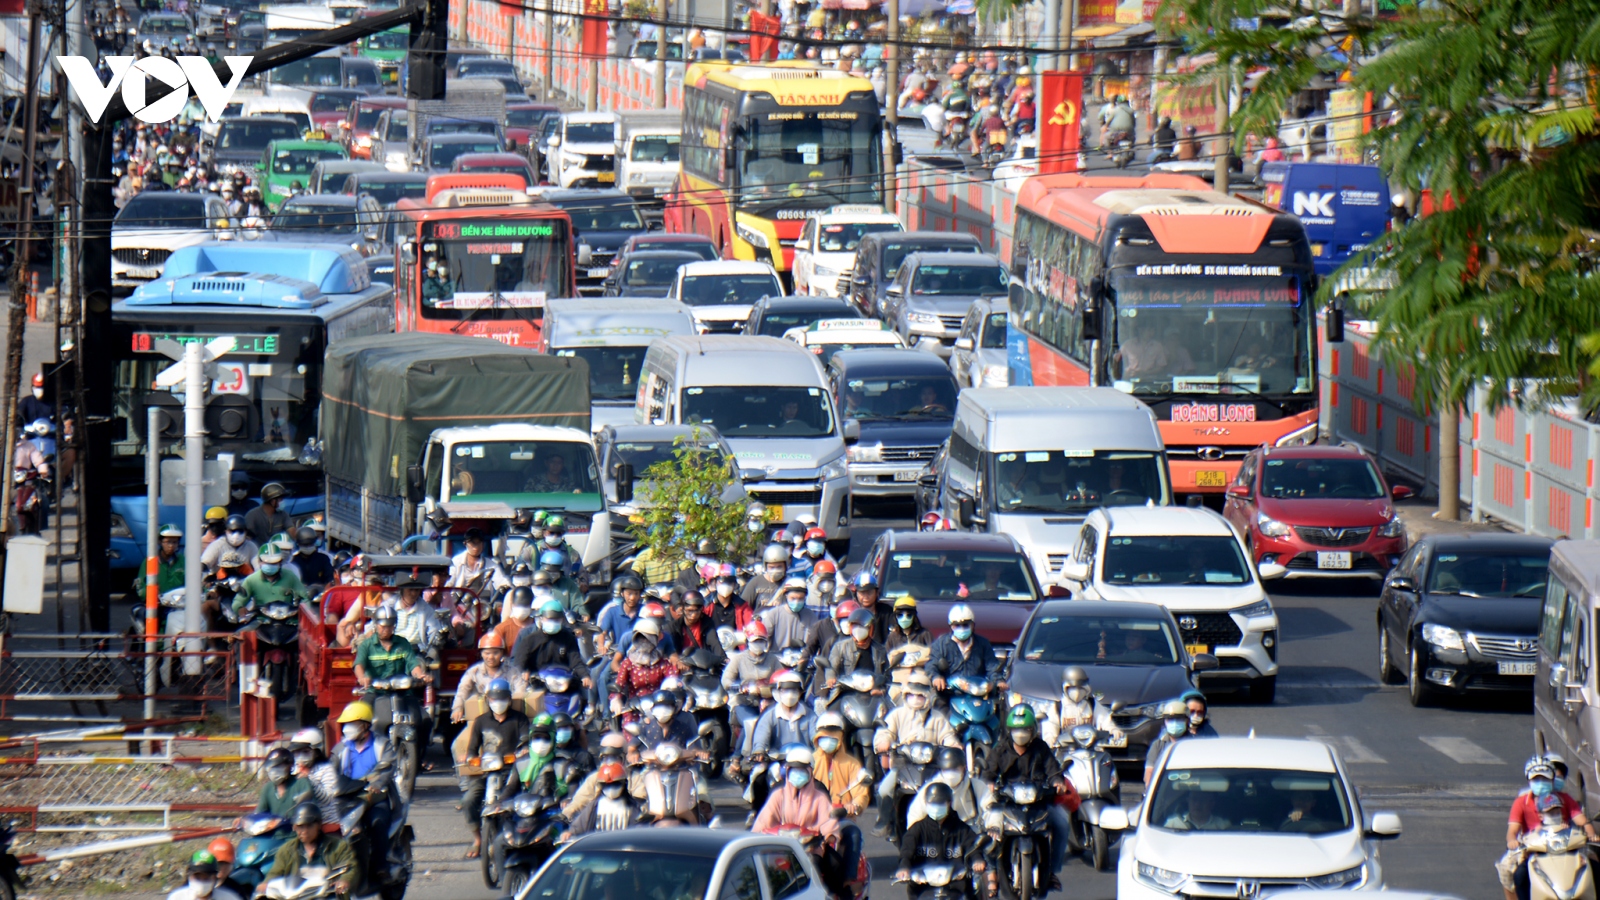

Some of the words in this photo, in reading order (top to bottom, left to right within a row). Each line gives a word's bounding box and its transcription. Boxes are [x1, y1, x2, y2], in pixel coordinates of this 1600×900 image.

[1293, 191, 1336, 217] NK
[481, 226, 493, 237] XE
[1219, 404, 1256, 422] LONG
